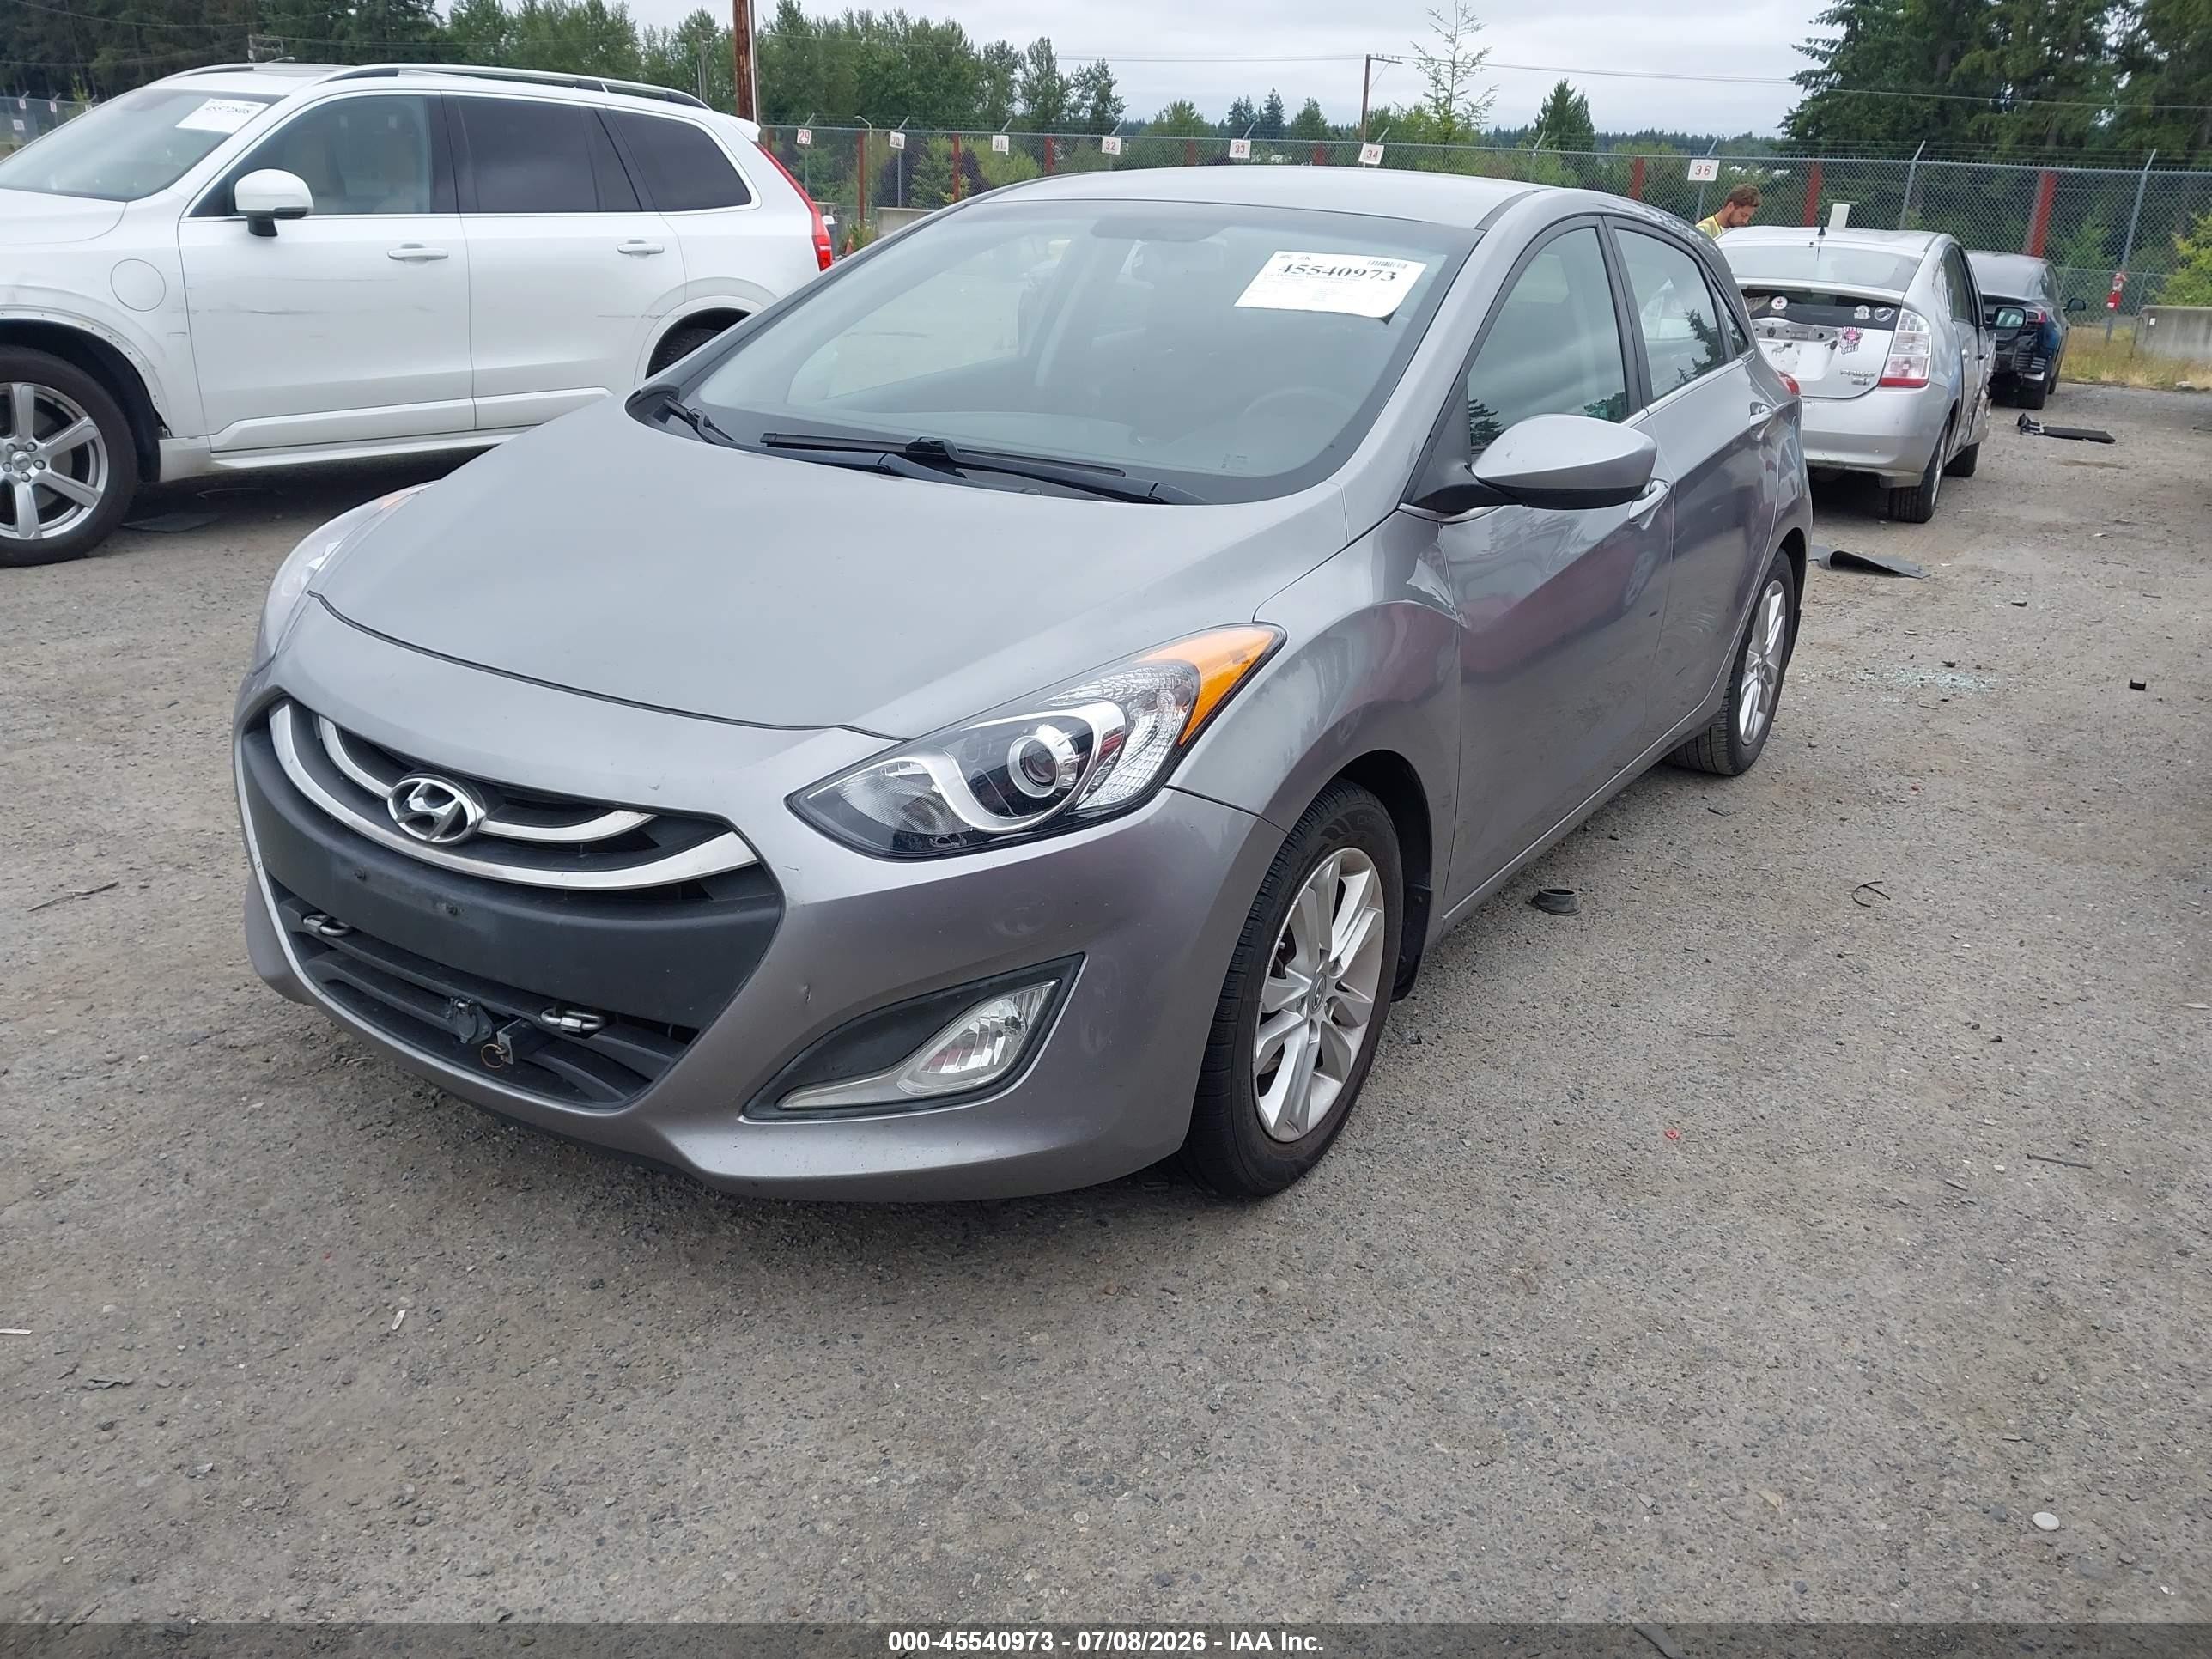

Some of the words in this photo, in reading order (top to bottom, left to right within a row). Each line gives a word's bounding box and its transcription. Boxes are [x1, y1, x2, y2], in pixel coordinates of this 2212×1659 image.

[799, 130, 810, 143] 29
[1106, 141, 1116, 151] 32
[1235, 144, 1245, 154] 33
[1366, 149, 1379, 161] 34
[1695, 165, 1711, 176] 36
[1277, 263, 1397, 282] 45540973
